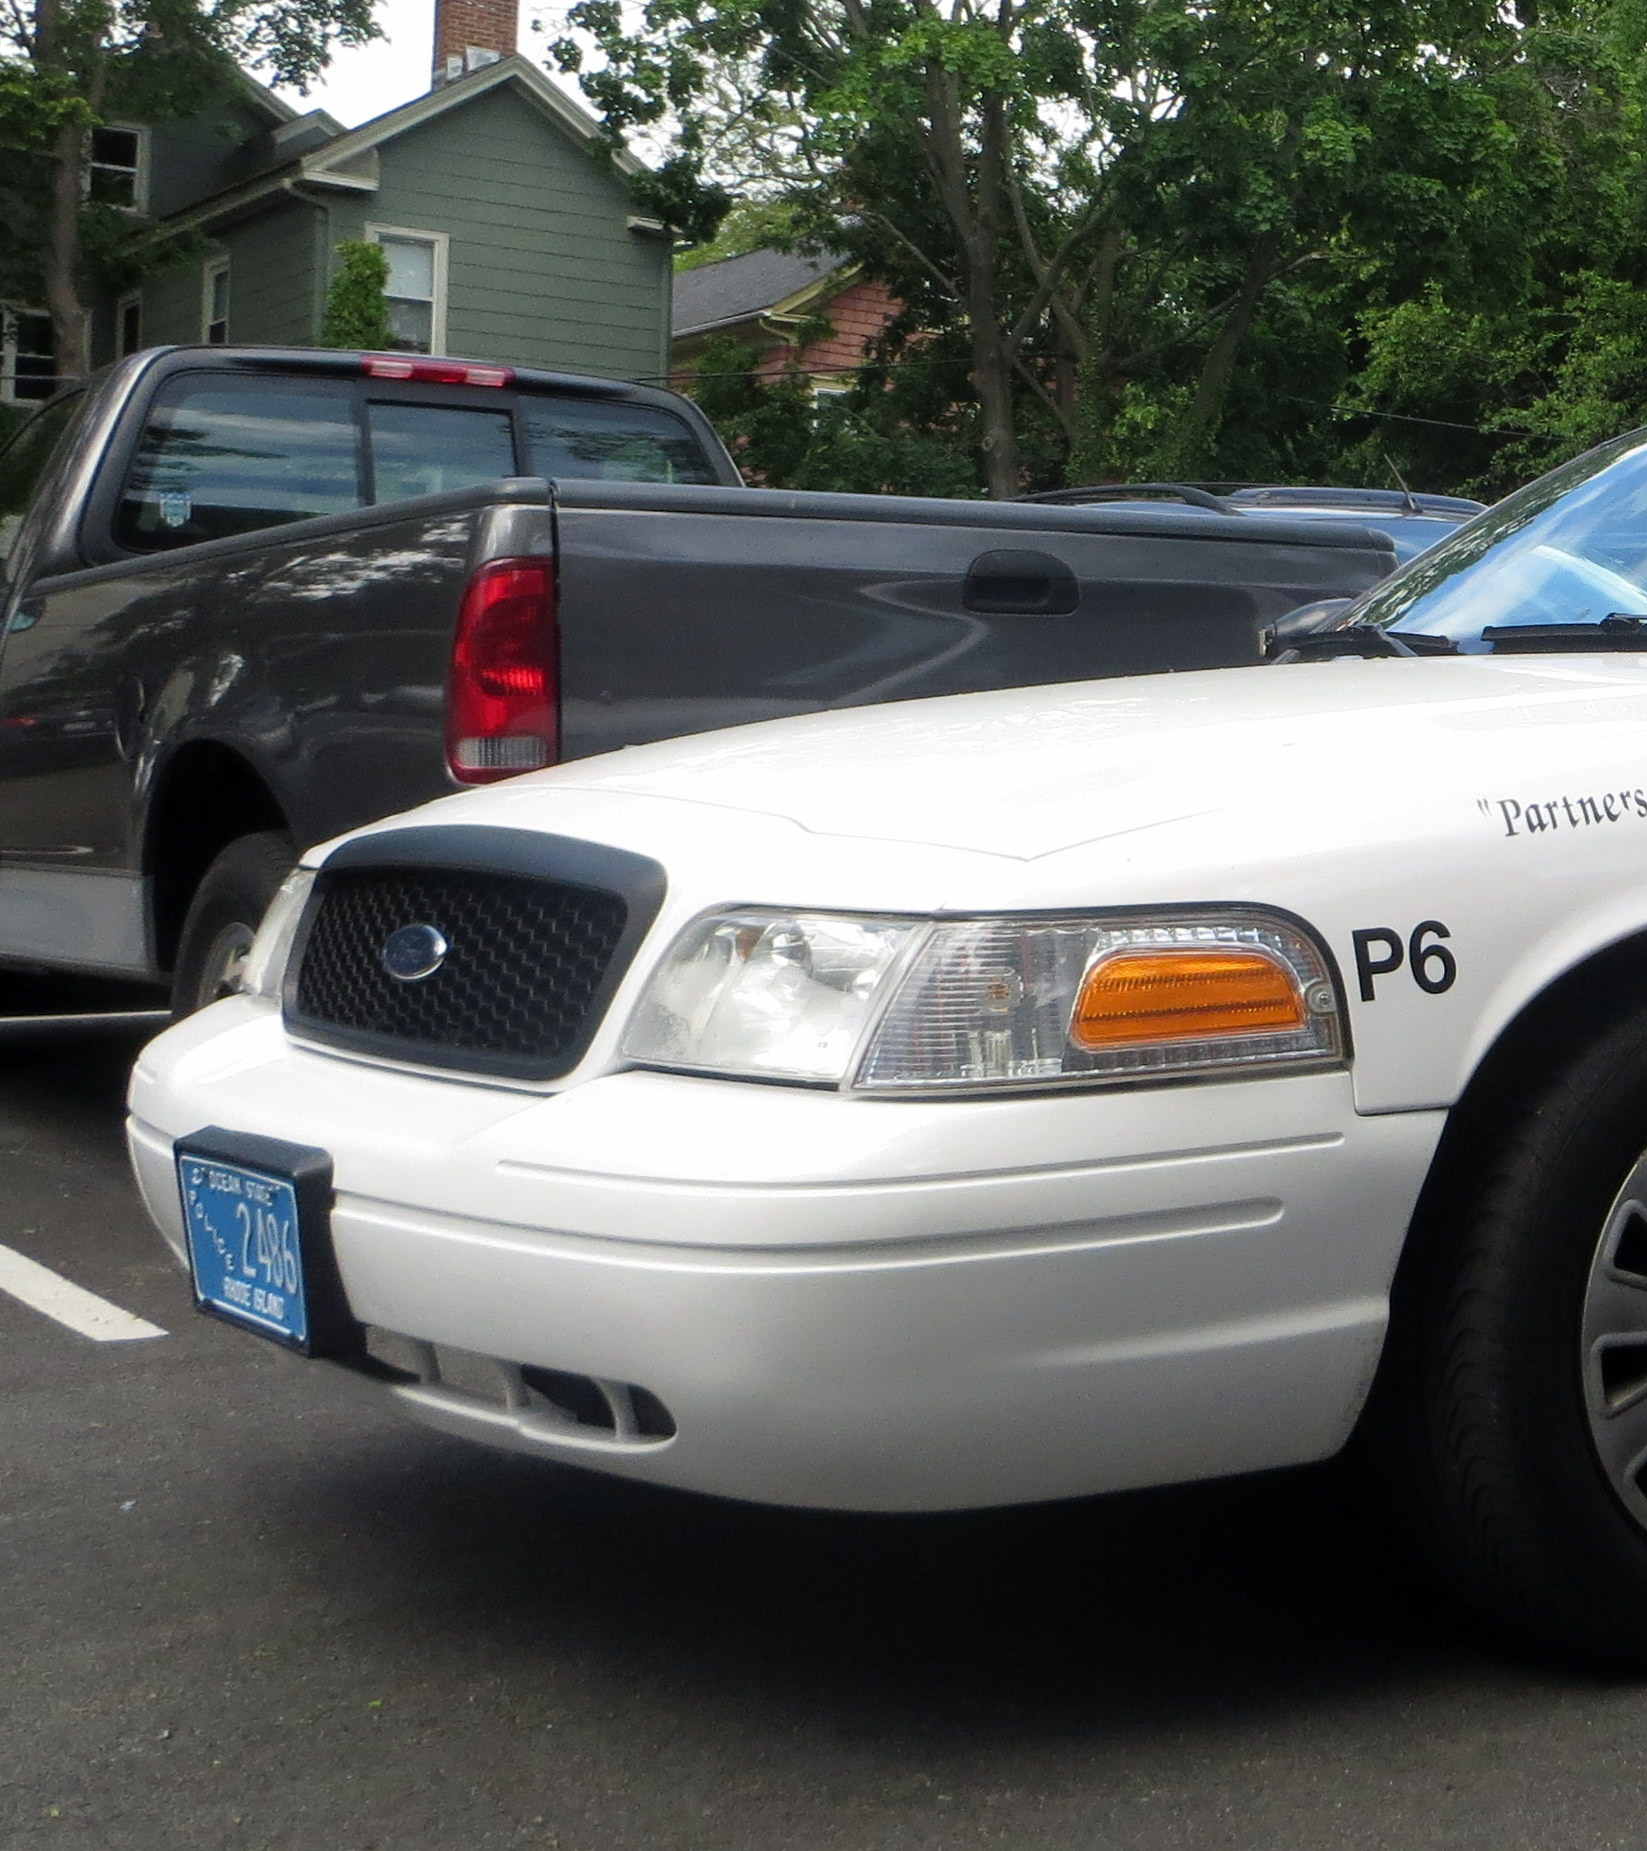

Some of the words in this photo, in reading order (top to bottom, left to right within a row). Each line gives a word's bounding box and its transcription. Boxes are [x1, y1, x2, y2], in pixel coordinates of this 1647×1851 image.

[1351, 920, 1457, 1003] P6
[188, 1189, 234, 1271] POLICE
[236, 1202, 298, 1295] 2486
